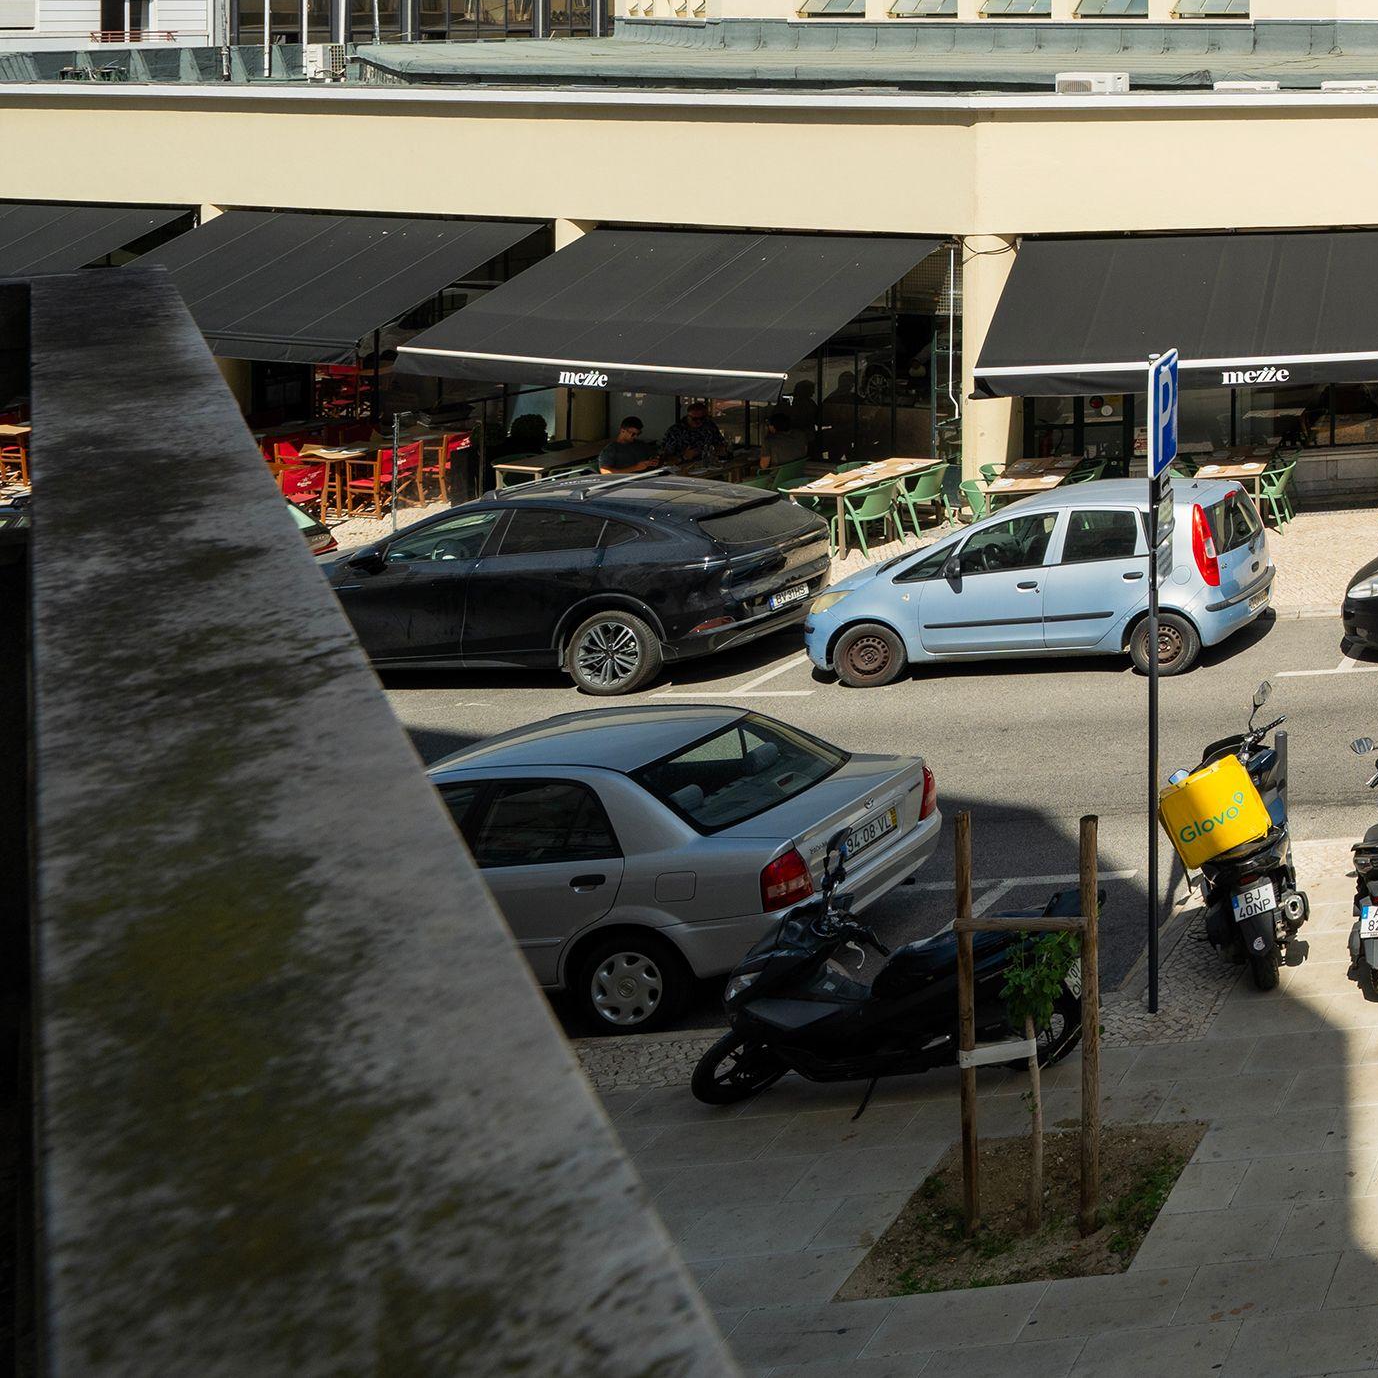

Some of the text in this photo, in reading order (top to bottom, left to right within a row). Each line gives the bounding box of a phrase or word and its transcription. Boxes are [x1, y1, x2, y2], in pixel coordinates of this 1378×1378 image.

[1158, 365, 1174, 463] P
[1179, 806, 1239, 844] Glovo
[1239, 899, 1271, 919] 40NP
[1245, 888, 1261, 905] BJ
